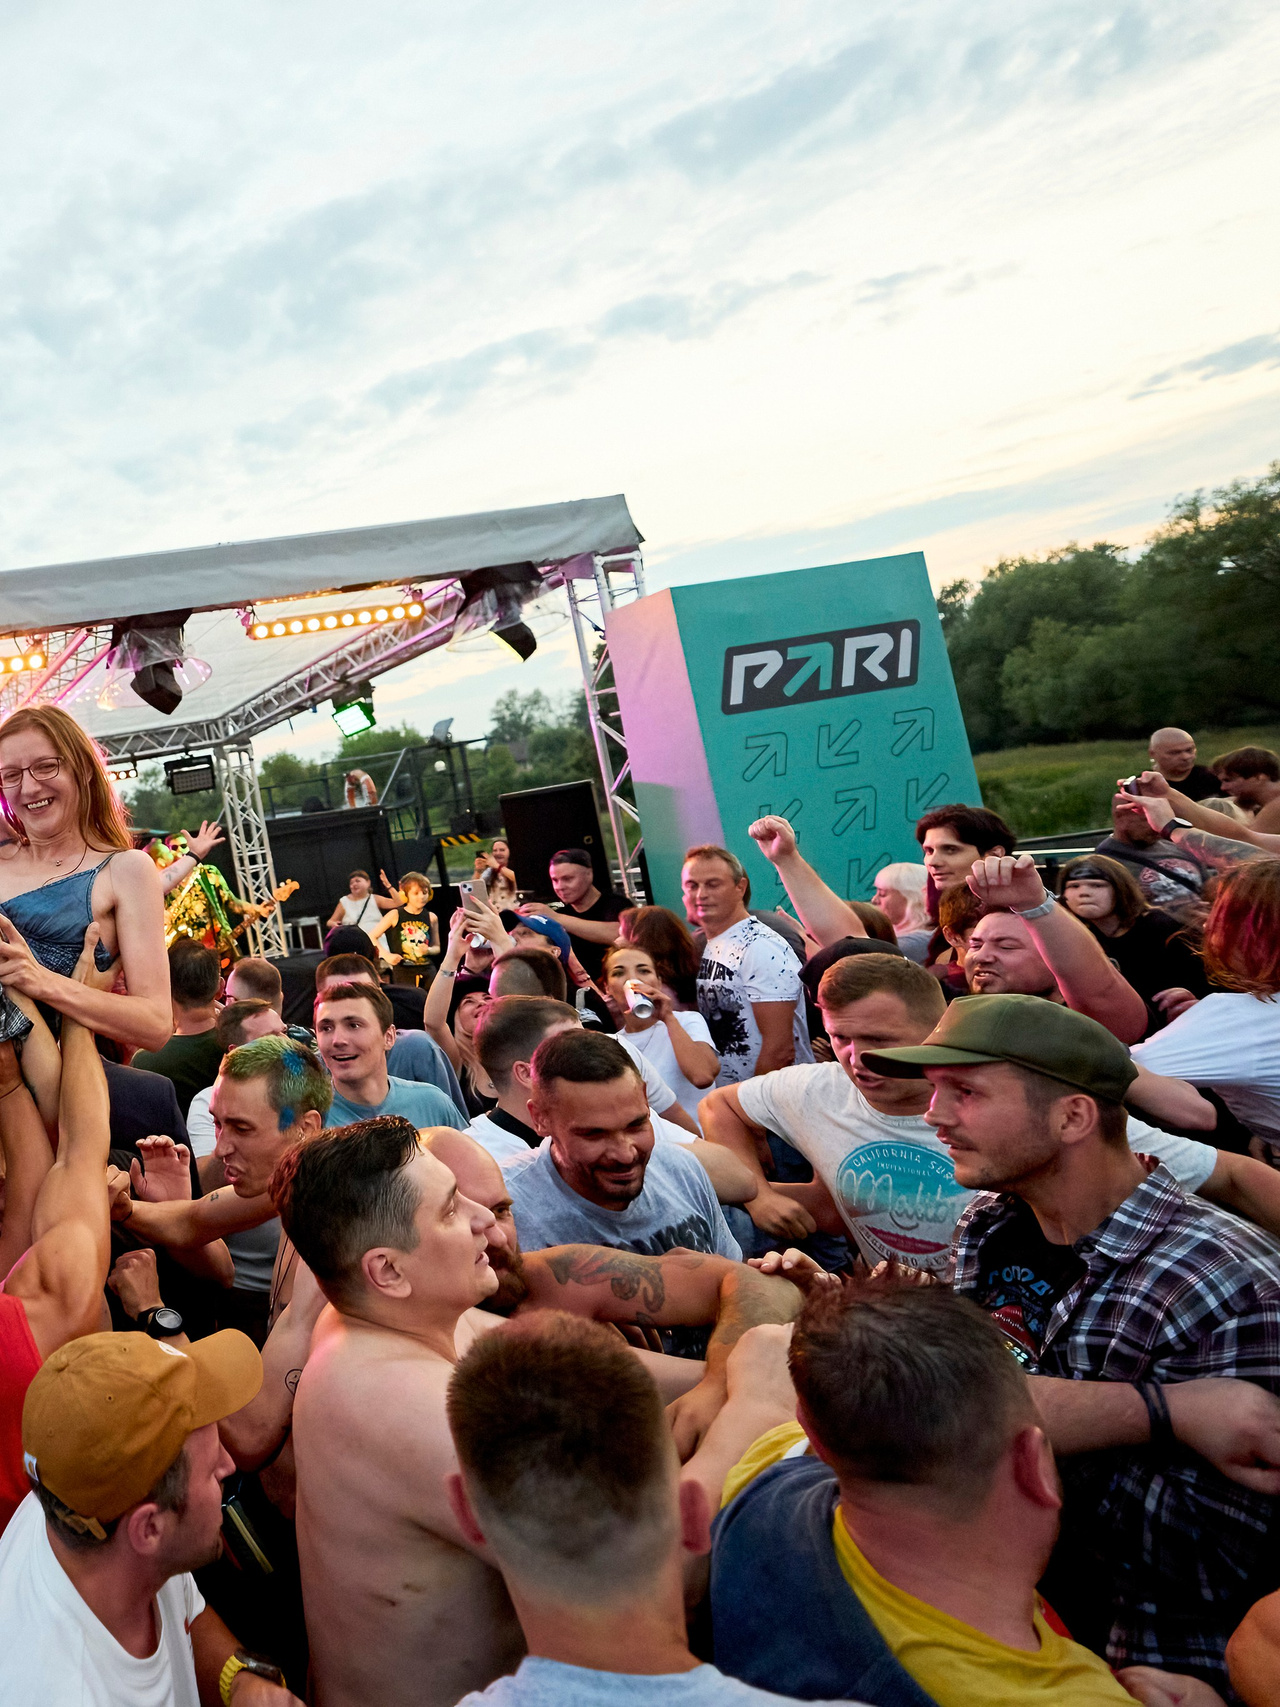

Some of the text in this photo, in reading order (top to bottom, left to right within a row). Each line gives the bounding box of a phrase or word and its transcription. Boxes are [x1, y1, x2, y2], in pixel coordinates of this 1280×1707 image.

[730, 628, 912, 706] PARI
[852, 1148, 954, 1180] CALIFORNIA SUR
